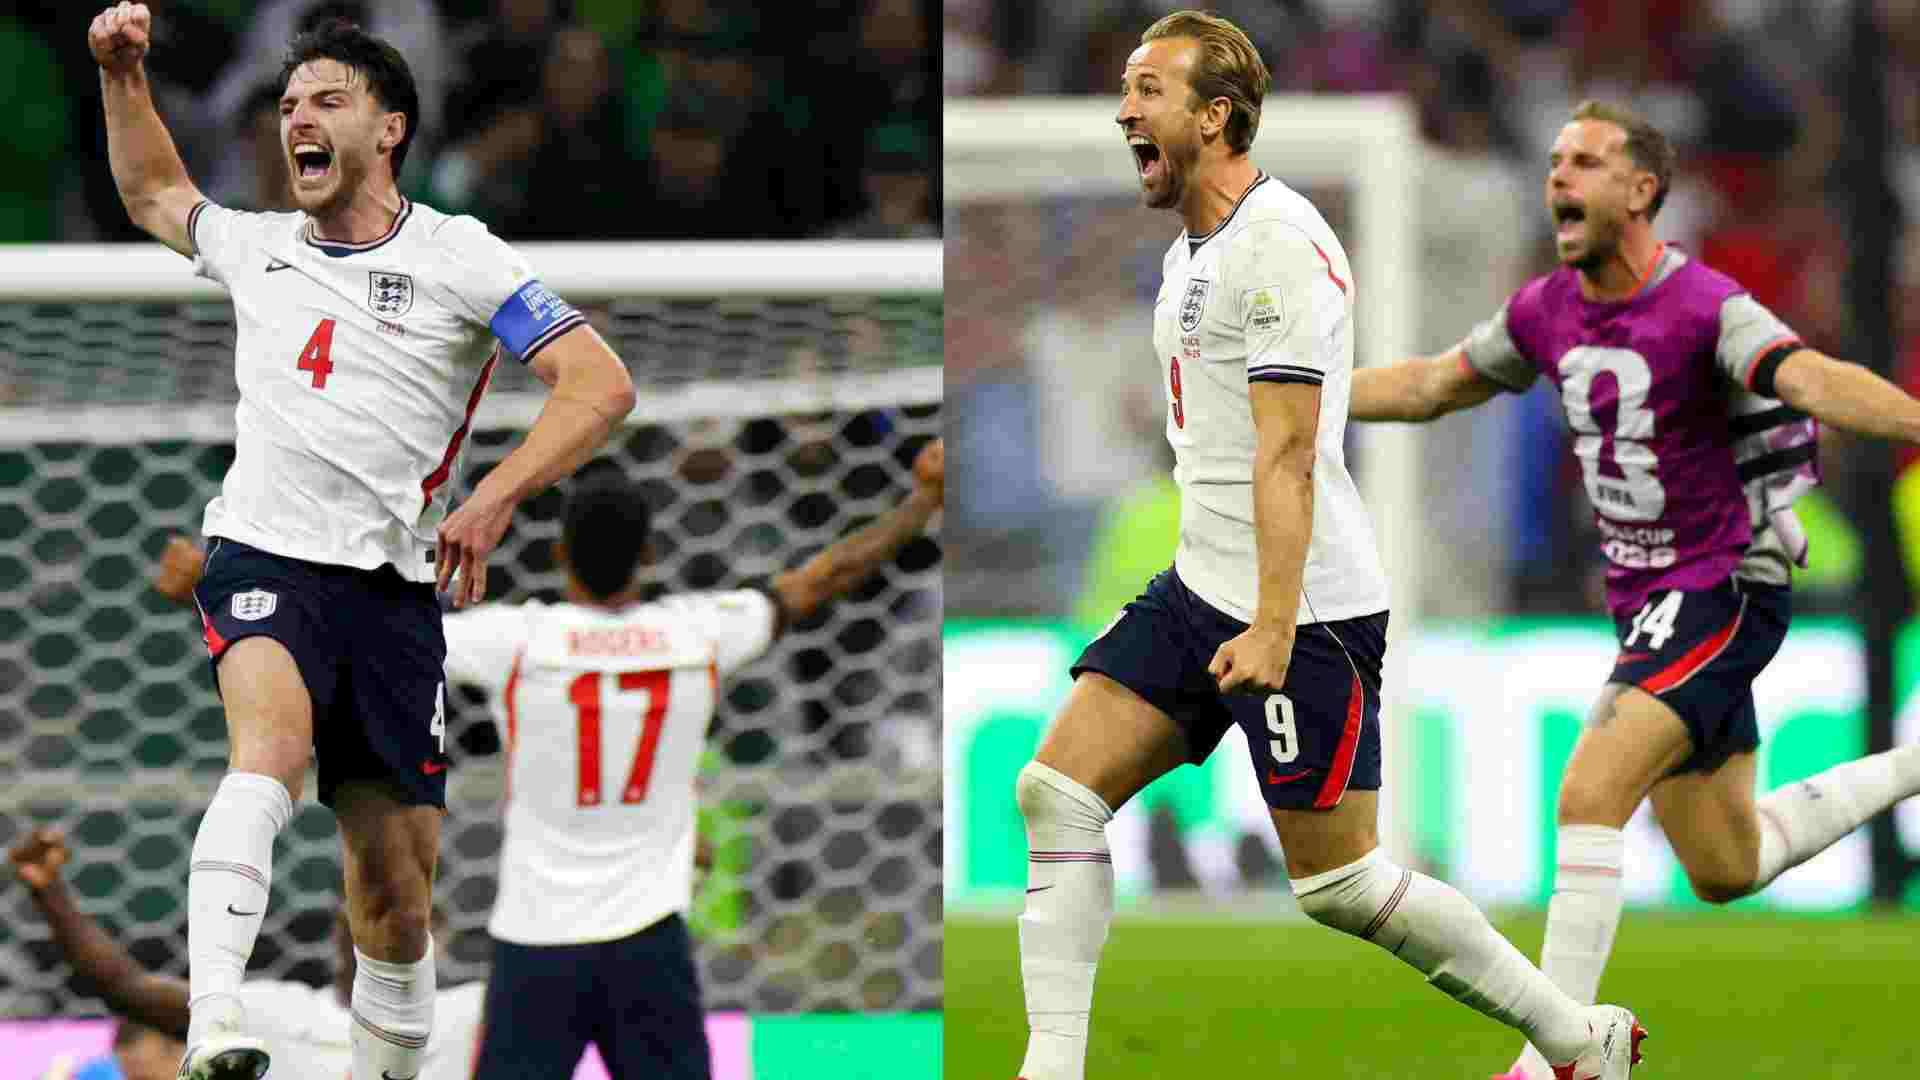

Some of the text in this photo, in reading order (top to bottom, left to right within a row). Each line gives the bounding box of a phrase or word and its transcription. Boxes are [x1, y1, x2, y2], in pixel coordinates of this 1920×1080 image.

[296, 318, 337, 390] 4
[568, 670, 672, 808] 17
[1263, 693, 1300, 765] 9
